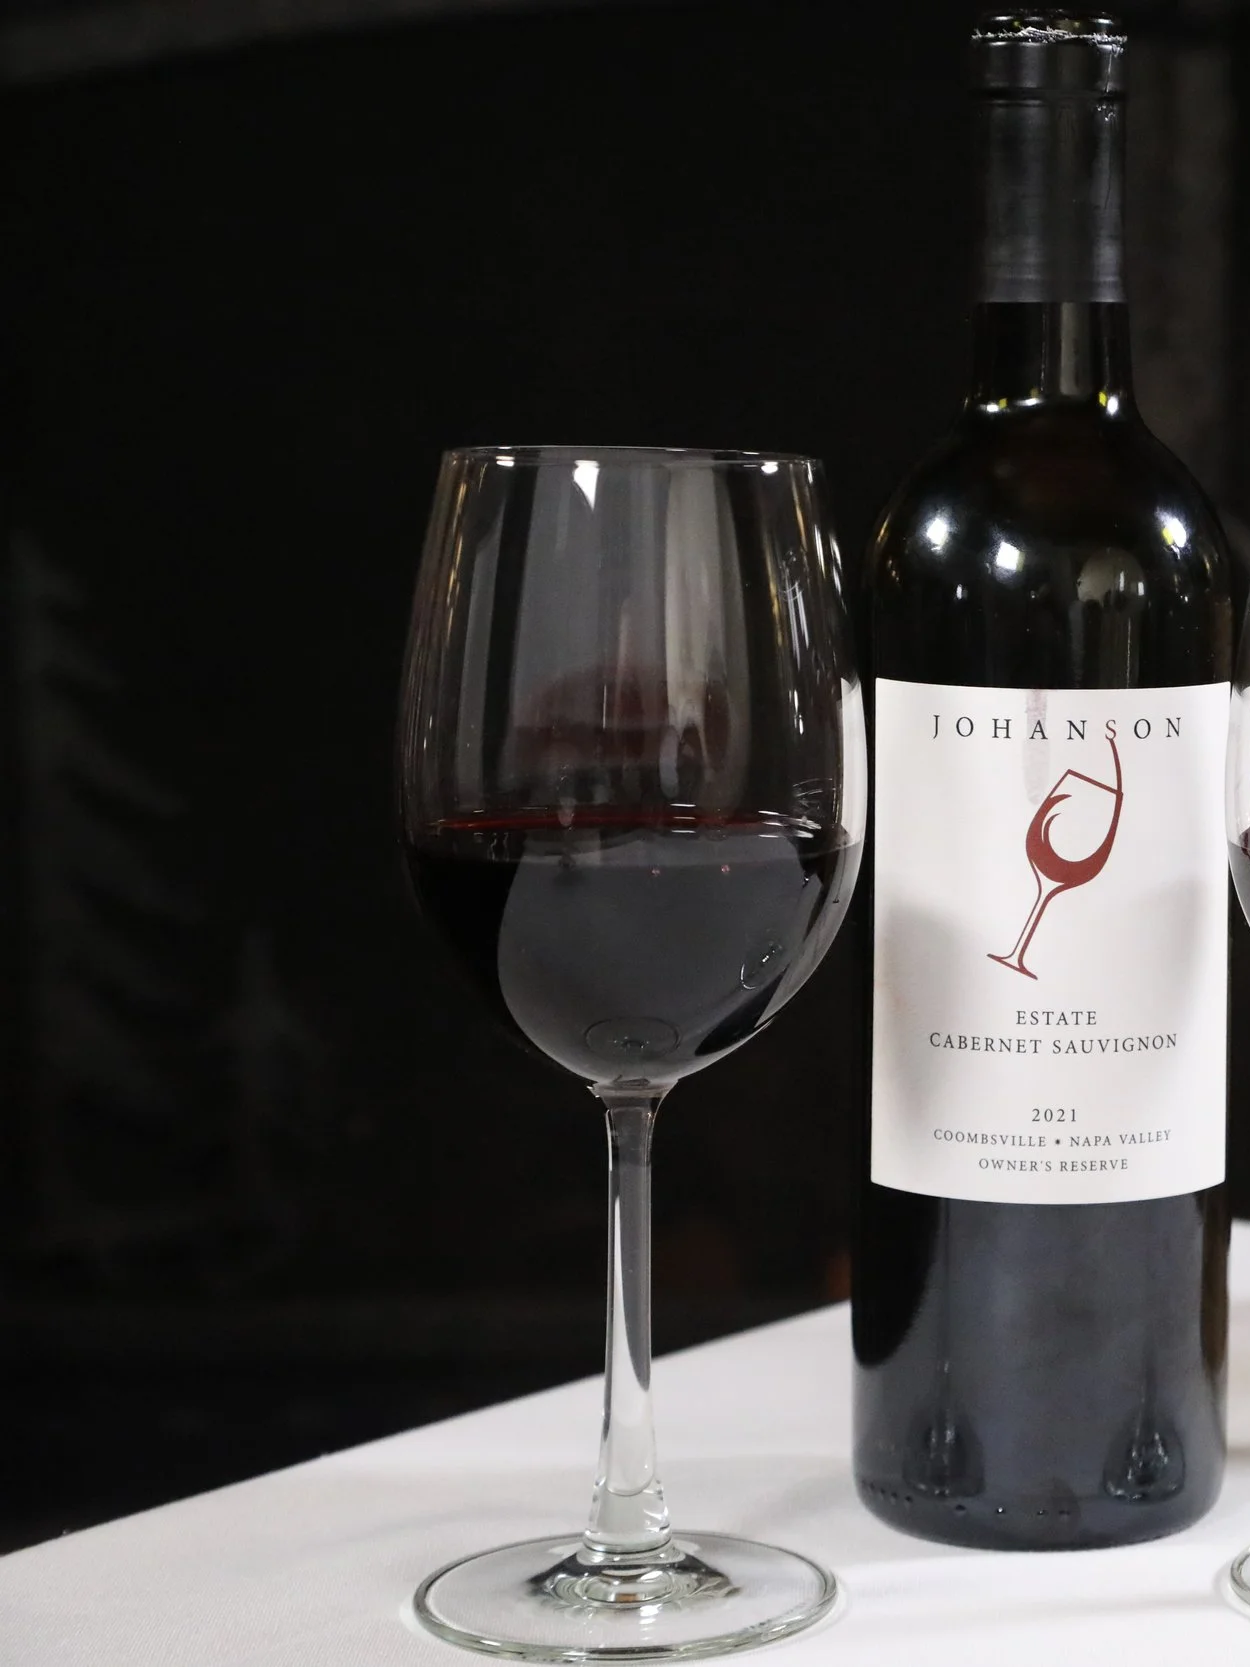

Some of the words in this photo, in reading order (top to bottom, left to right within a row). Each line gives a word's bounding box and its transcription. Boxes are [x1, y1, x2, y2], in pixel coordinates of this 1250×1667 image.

[932, 714, 1182, 741] JOHANSON
[1015, 1010, 1098, 1026] ESTATE
[929, 1032, 1042, 1054] CABERNET
[1052, 1033, 1178, 1054] SAUVIGNON
[1031, 1108, 1078, 1123] 2021
[933, 1128, 1047, 1148] COOMBSVILLE
[1069, 1135, 1112, 1148] NAPA
[1118, 1129, 1172, 1145] VALLEY
[978, 1158, 1053, 1173] OWNER'S
[1059, 1158, 1129, 1173] RESERVE
